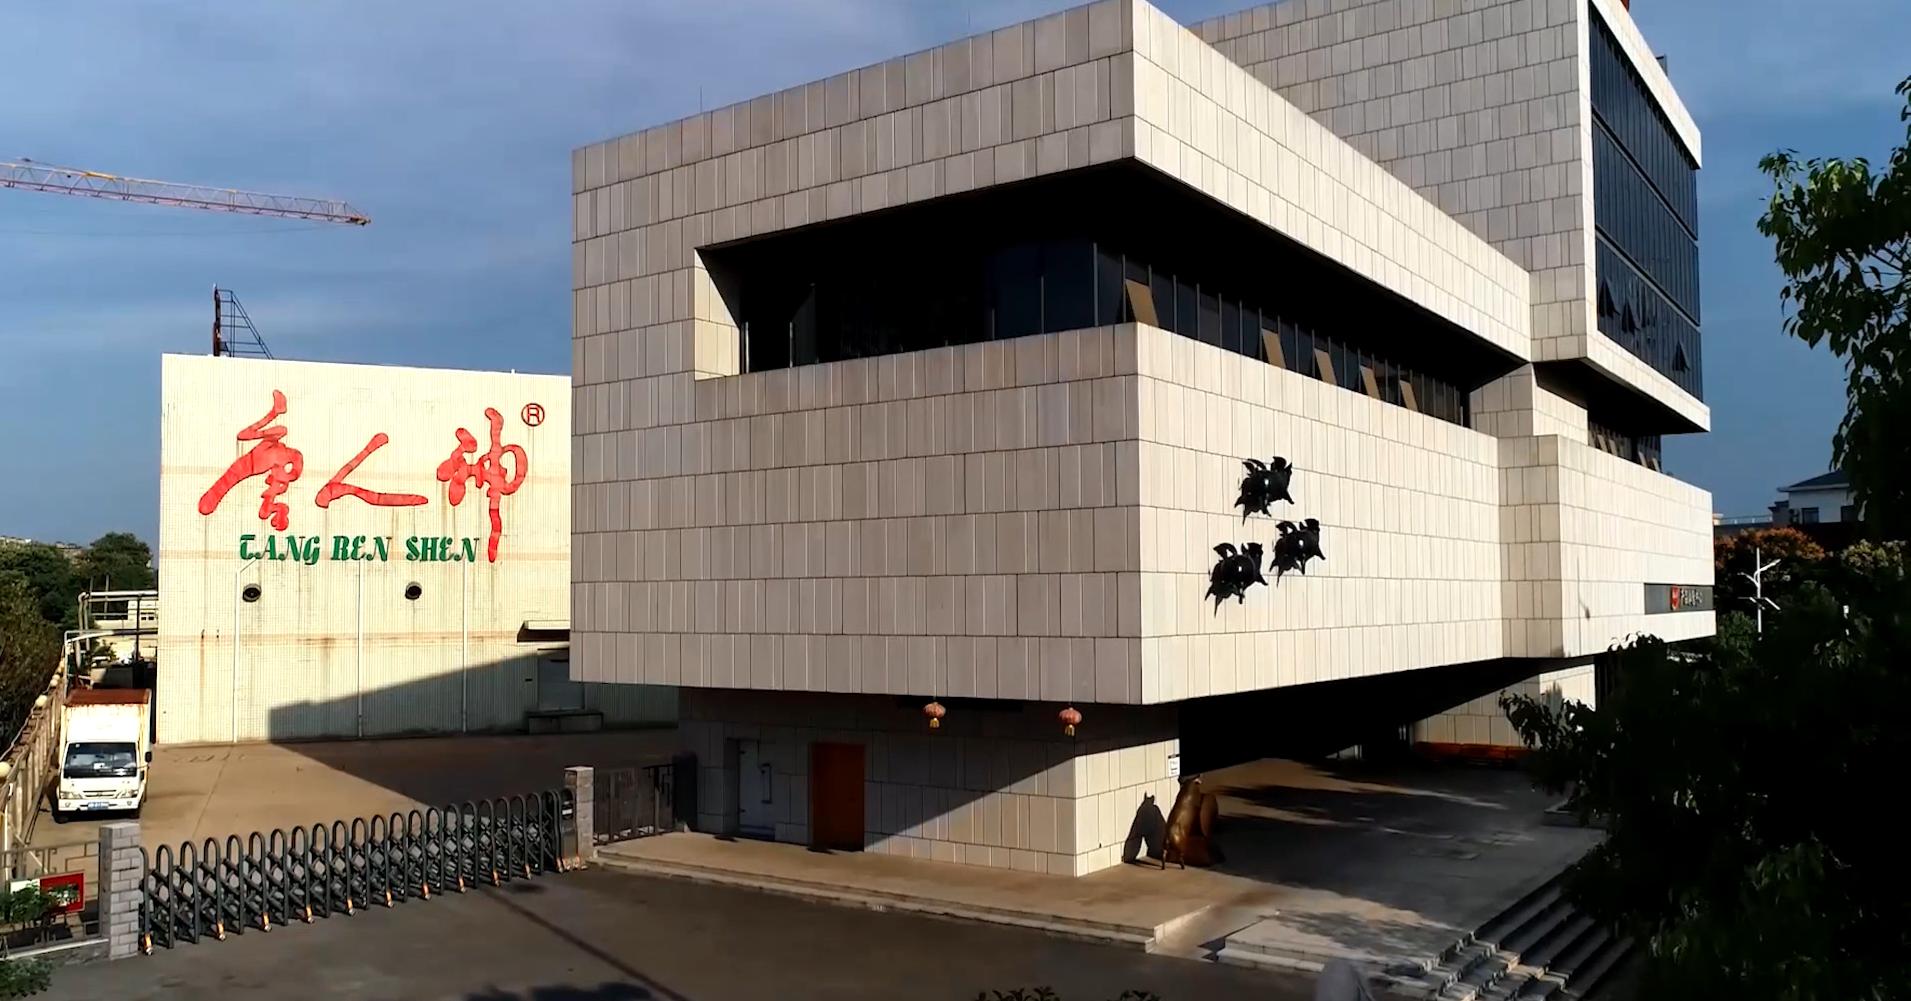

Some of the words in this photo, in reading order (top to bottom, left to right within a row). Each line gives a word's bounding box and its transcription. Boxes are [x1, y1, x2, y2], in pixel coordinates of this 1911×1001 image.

[198, 389, 528, 563] 唐人神
[239, 534, 321, 566] TANG
[330, 535, 392, 562] REN
[405, 535, 480, 563] SHEN
